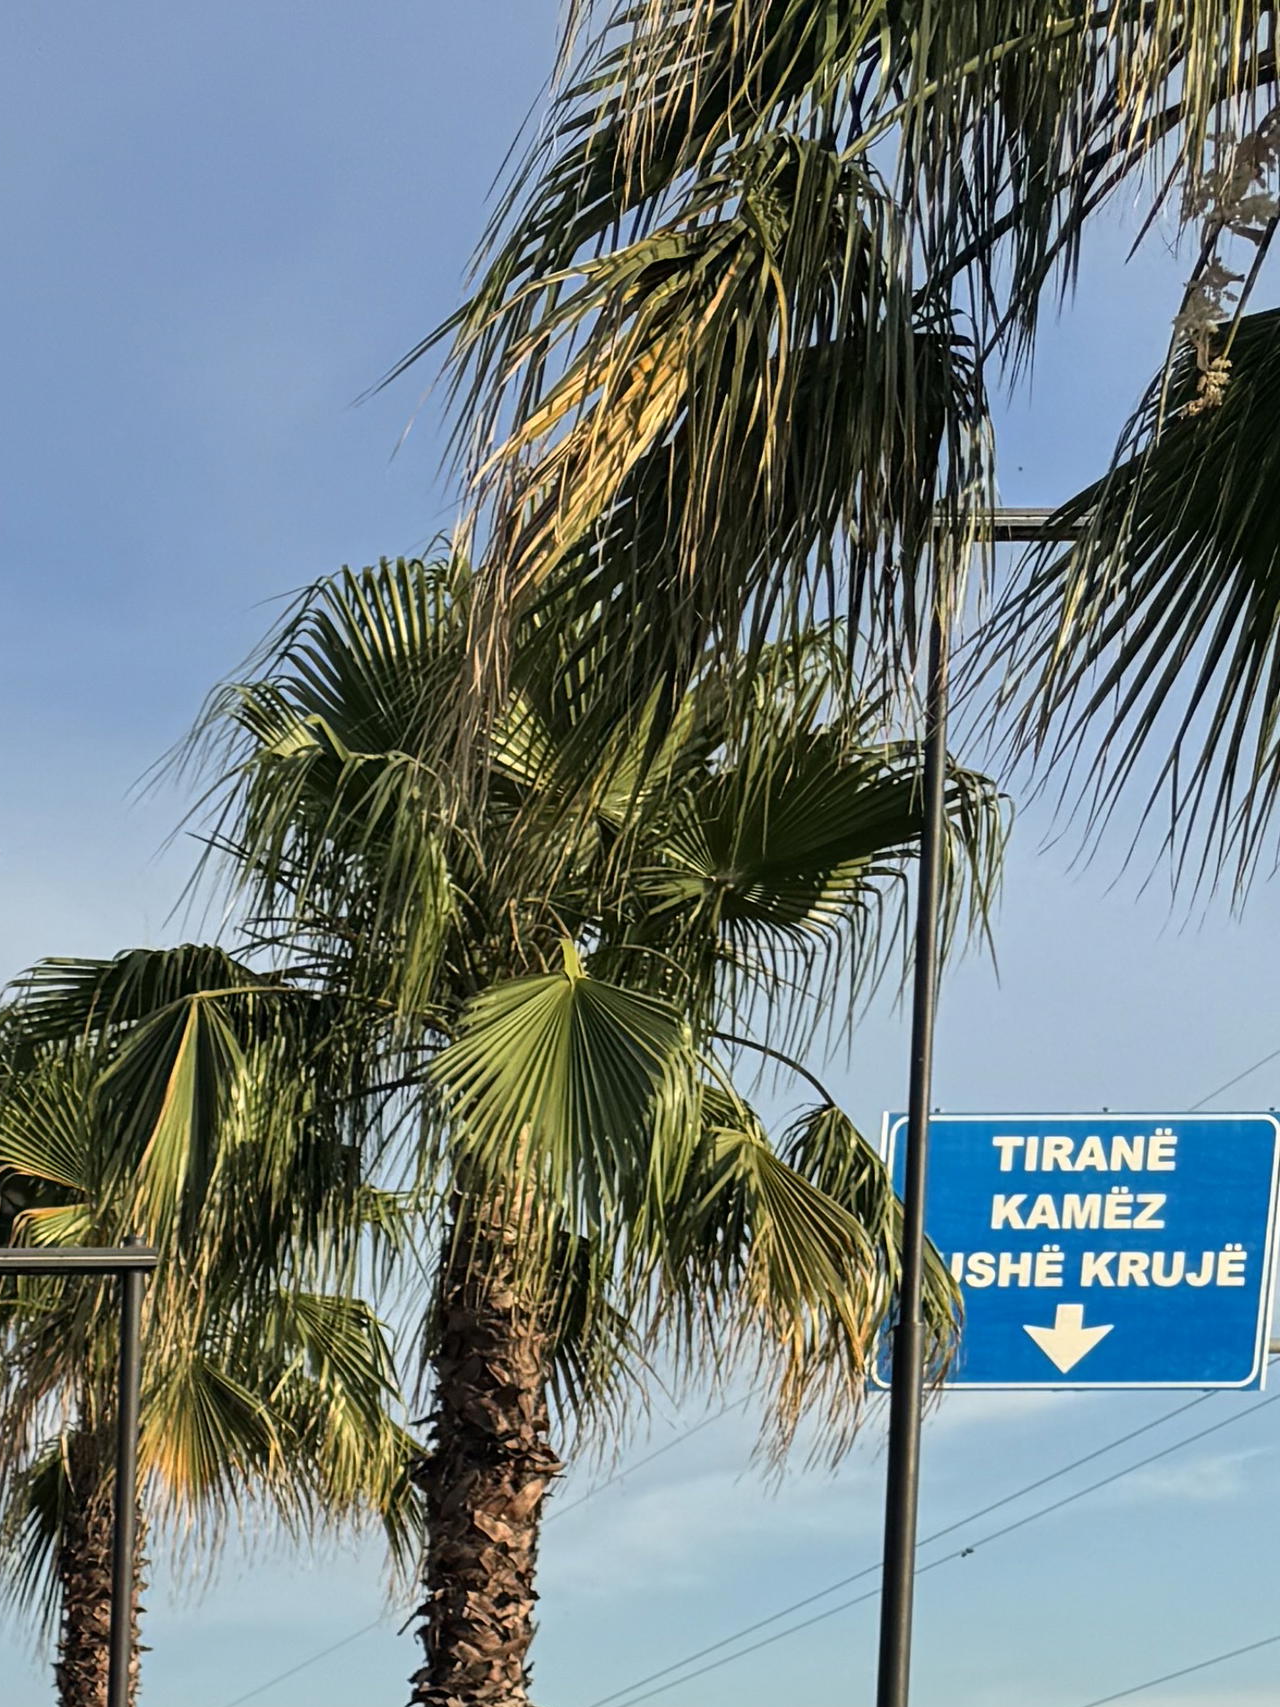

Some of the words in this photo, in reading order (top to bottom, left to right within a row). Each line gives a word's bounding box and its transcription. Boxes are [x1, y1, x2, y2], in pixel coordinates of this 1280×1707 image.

[992, 1128, 1178, 1172] TIRANË
[990, 1186, 1167, 1230] KAMËZ
[1080, 1243, 1248, 1288] KRUJË
